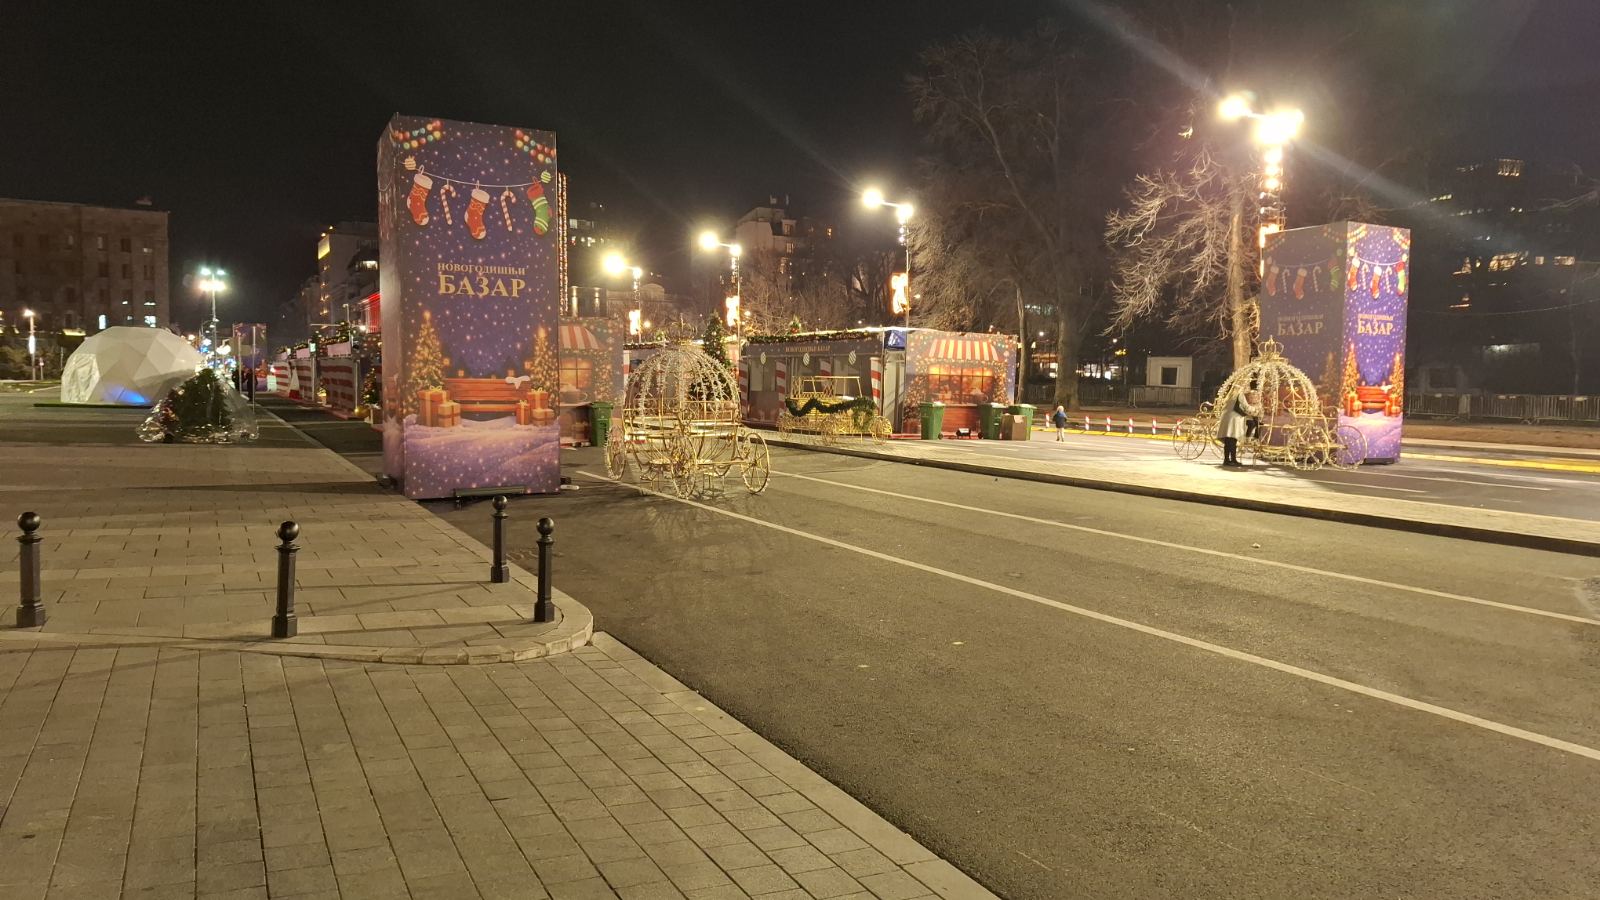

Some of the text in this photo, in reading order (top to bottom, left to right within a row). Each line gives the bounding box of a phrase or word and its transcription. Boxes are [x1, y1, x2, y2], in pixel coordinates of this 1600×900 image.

[438, 274, 526, 298] БАЗАР
[1277, 321, 1323, 336] БАЗАР
[1357, 319, 1394, 336] БАЗАР
